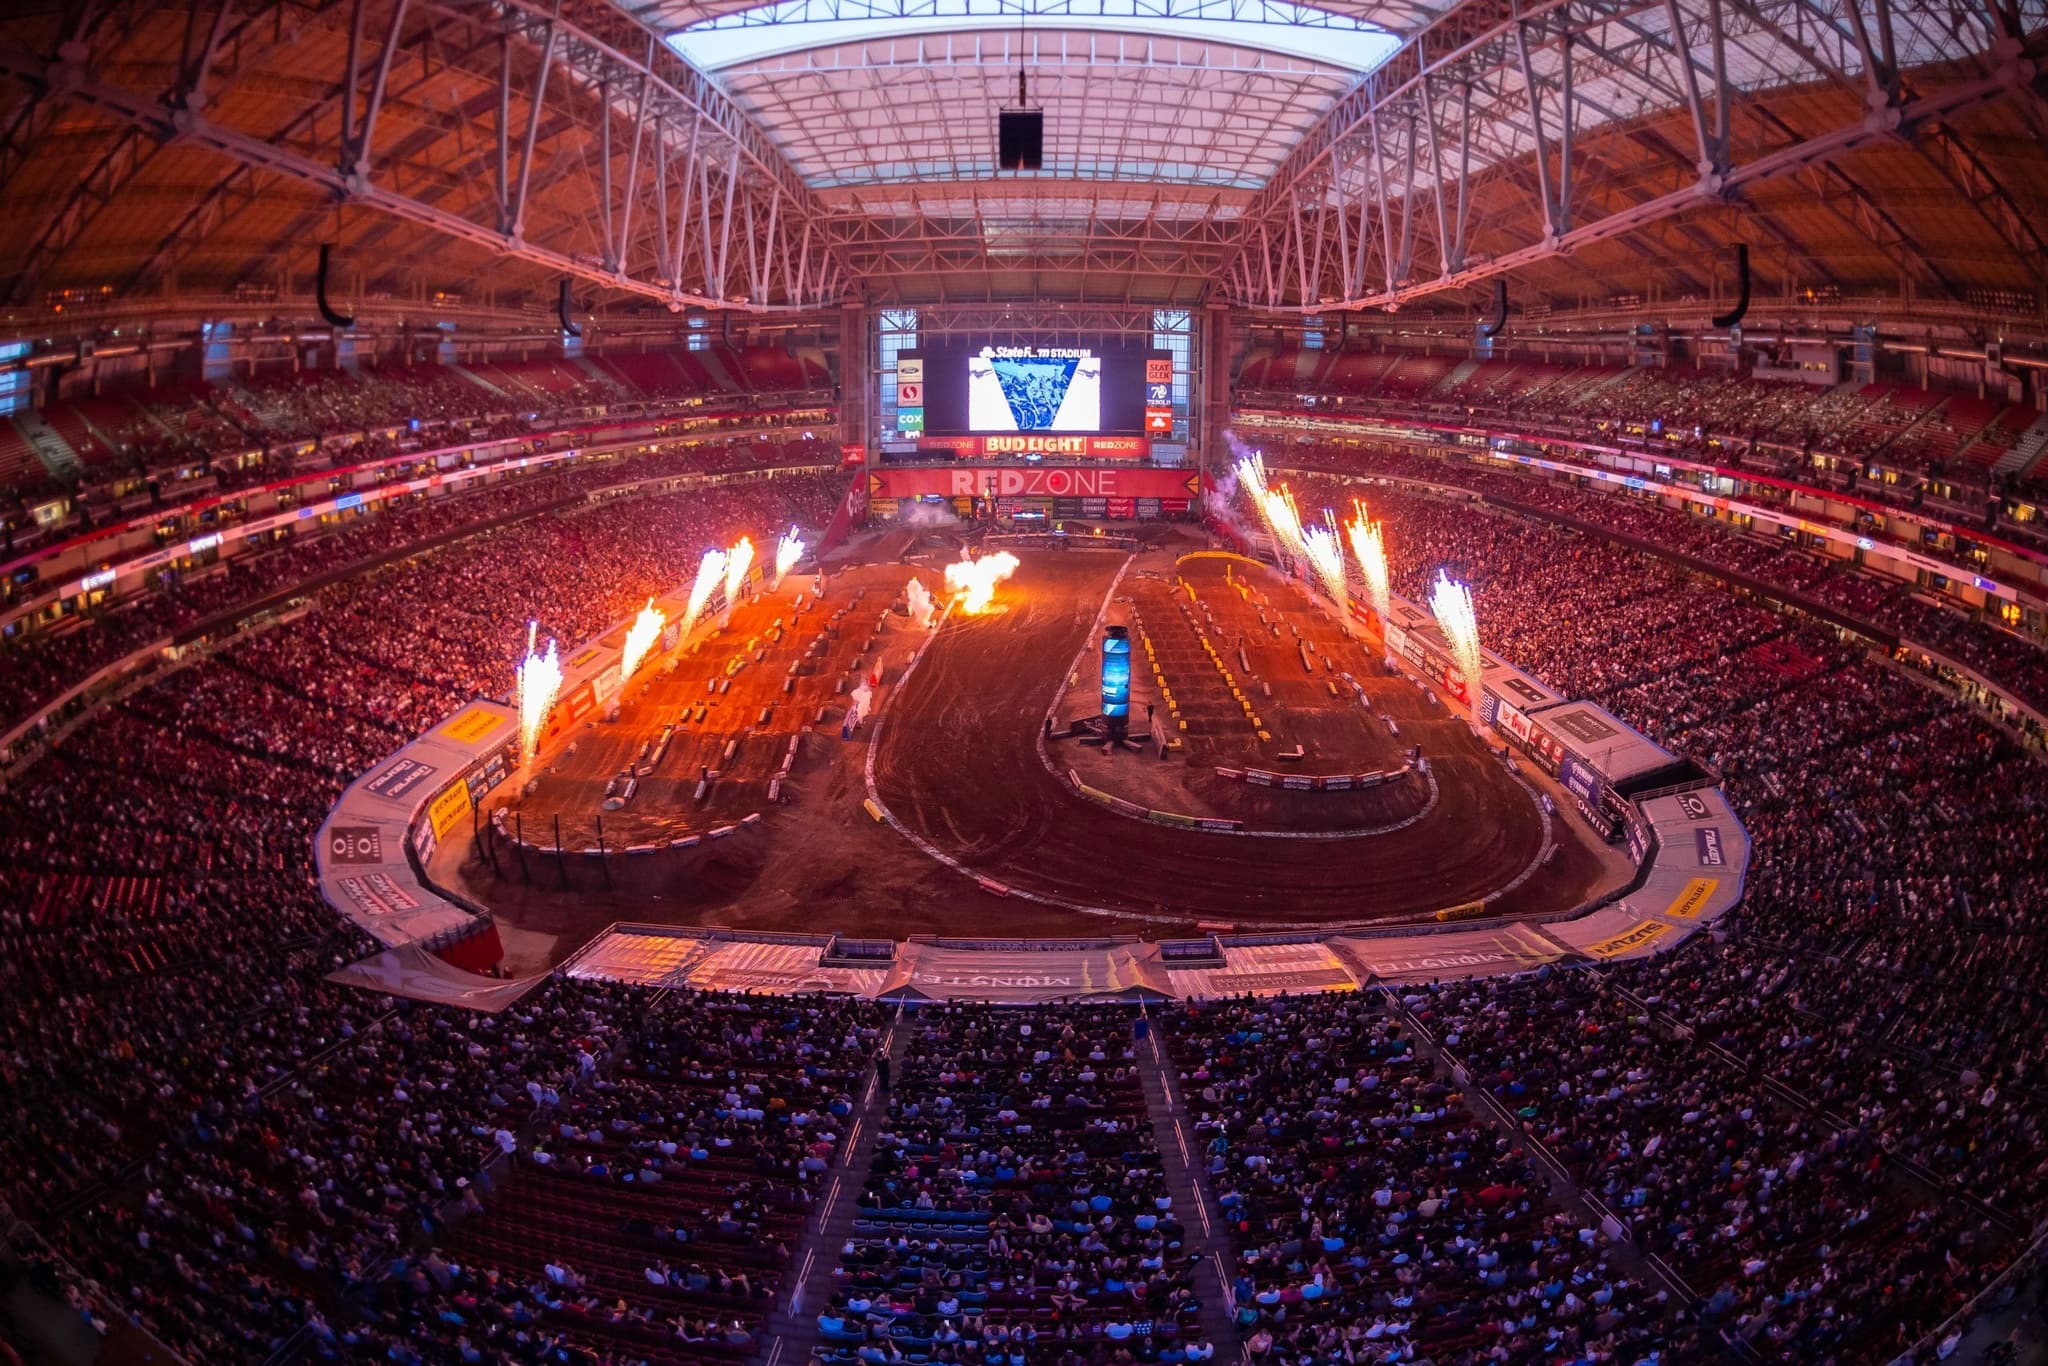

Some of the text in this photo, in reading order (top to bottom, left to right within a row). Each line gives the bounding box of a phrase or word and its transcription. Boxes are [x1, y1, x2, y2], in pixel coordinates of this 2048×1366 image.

[1050, 348, 1092, 358] STADIUM
[899, 415, 921, 423] COX
[986, 437, 1082, 452] BUD LIGHT
[1093, 440, 1139, 449] REDZONE
[951, 470, 1117, 495] REDZONE
[368, 760, 411, 791] FALKEN
[386, 765, 429, 797] FALKEN
[1704, 829, 1721, 865] FALKEN
[1680, 886, 1705, 915] DUNLOP
[1593, 922, 1663, 954] SUZUKI
